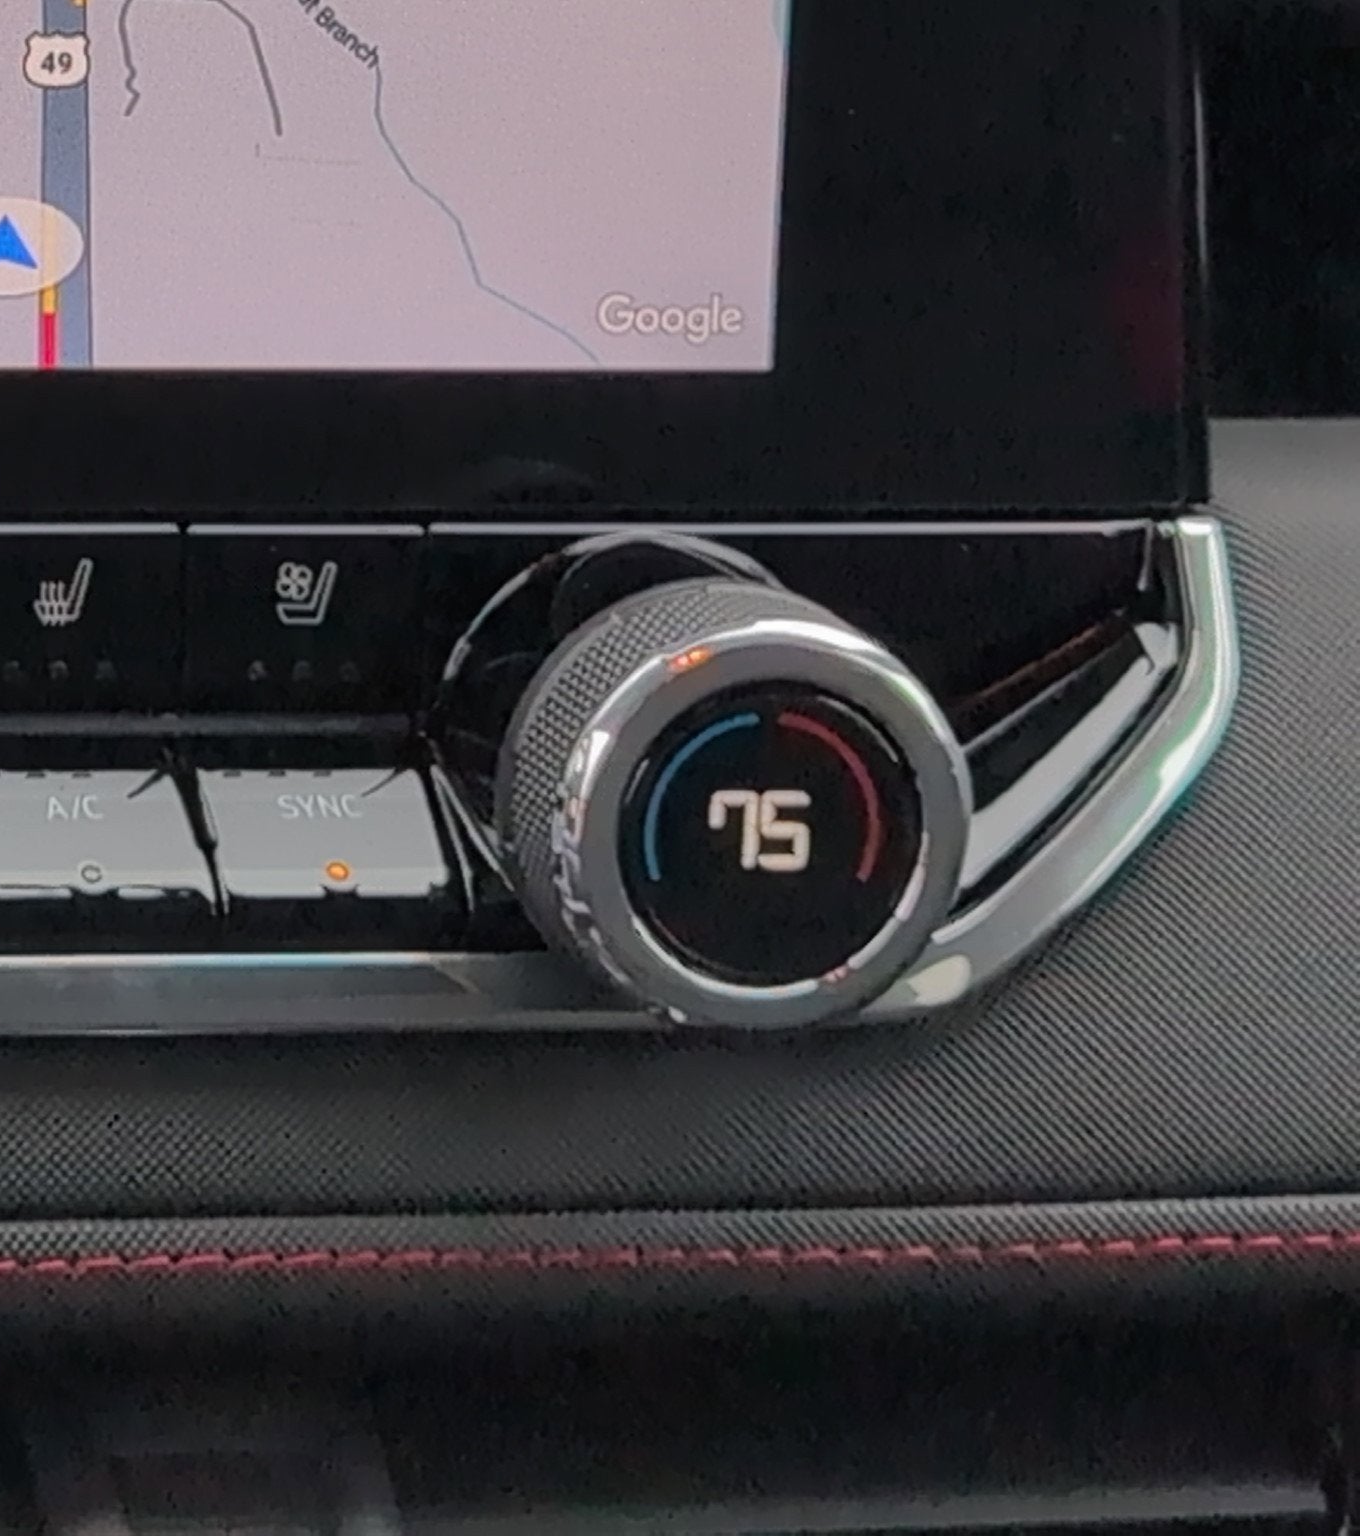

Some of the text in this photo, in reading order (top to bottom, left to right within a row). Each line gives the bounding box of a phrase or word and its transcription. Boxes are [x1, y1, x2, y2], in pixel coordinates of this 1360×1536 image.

[313, 6, 379, 70] Branch
[40, 52, 73, 74] 49
[597, 294, 743, 342] Google
[46, 794, 105, 821] A/C
[277, 793, 364, 820] SYNC
[707, 789, 812, 873] 75
